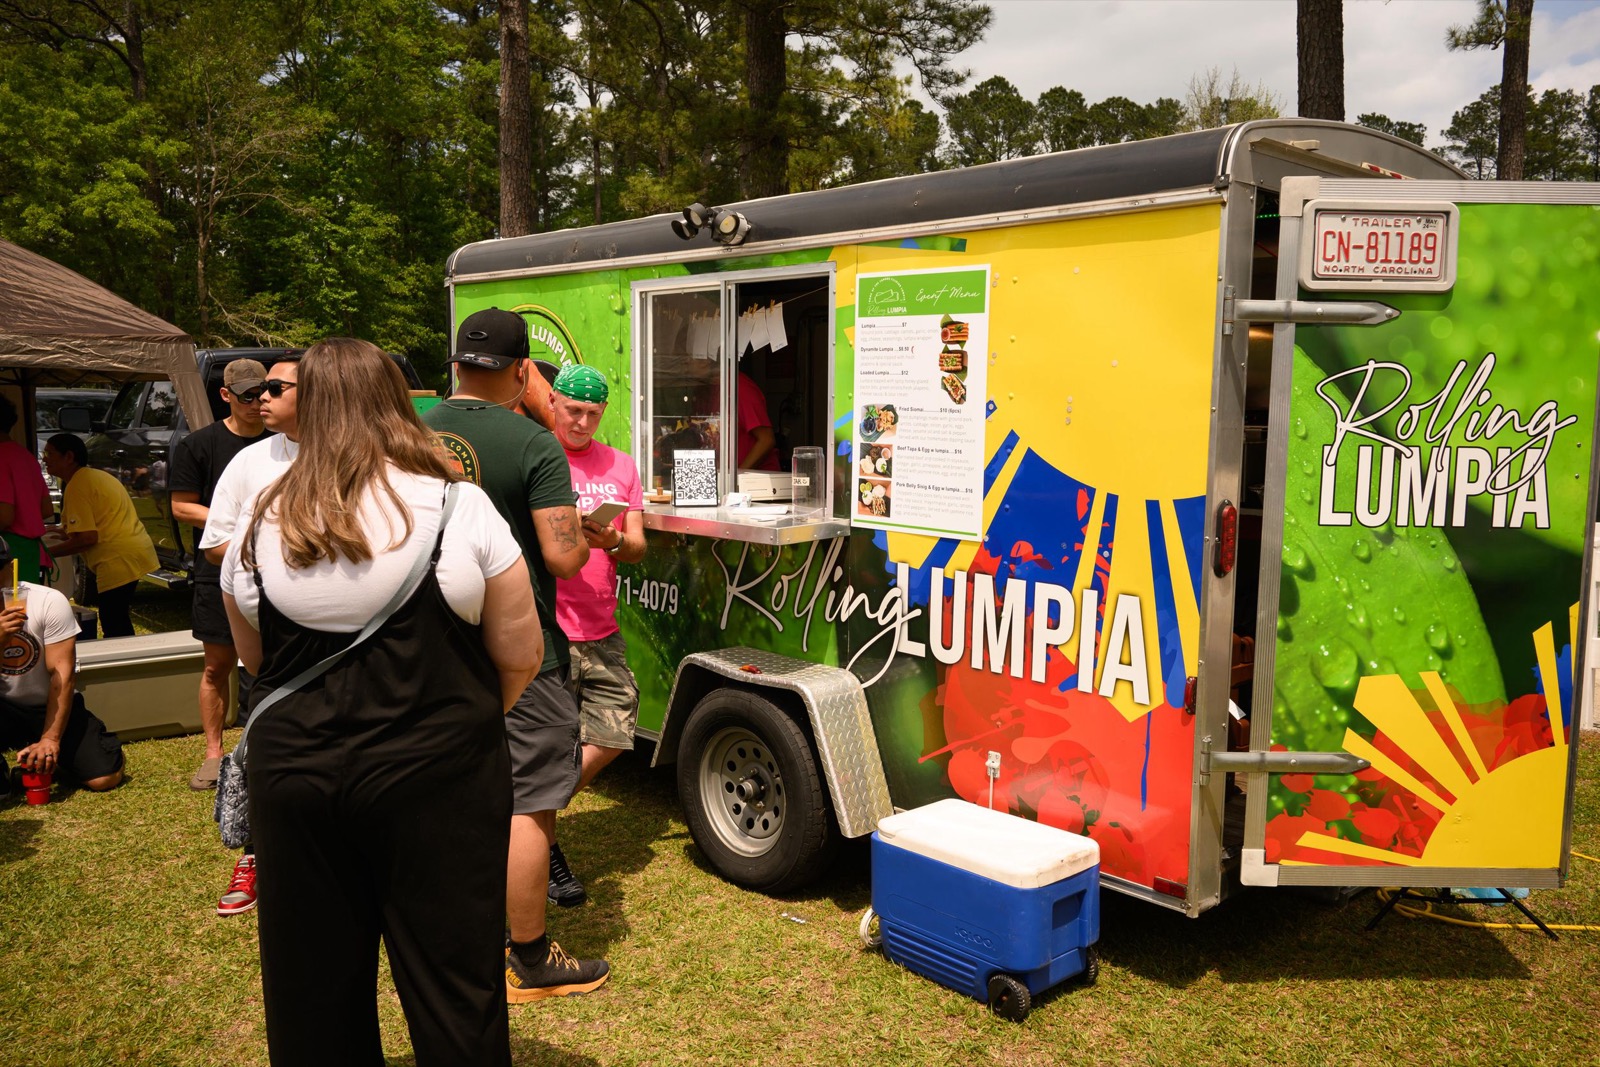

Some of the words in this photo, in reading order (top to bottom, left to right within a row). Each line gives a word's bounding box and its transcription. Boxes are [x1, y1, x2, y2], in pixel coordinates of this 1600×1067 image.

[1352, 218, 1411, 227] TRAILER
[1322, 231, 1437, 264] CN-81189
[1373, 266, 1432, 274] CAROLINA
[916, 284, 948, 306] Event
[949, 286, 980, 298] Menu
[1315, 352, 1578, 495] Rolling
[572, 482, 618, 494] LING
[1318, 444, 1550, 529] LUMPIA
[616, 575, 678, 615] 71-4079
[712, 537, 922, 689] Rolling
[897, 562, 1150, 706] LUMPIA
